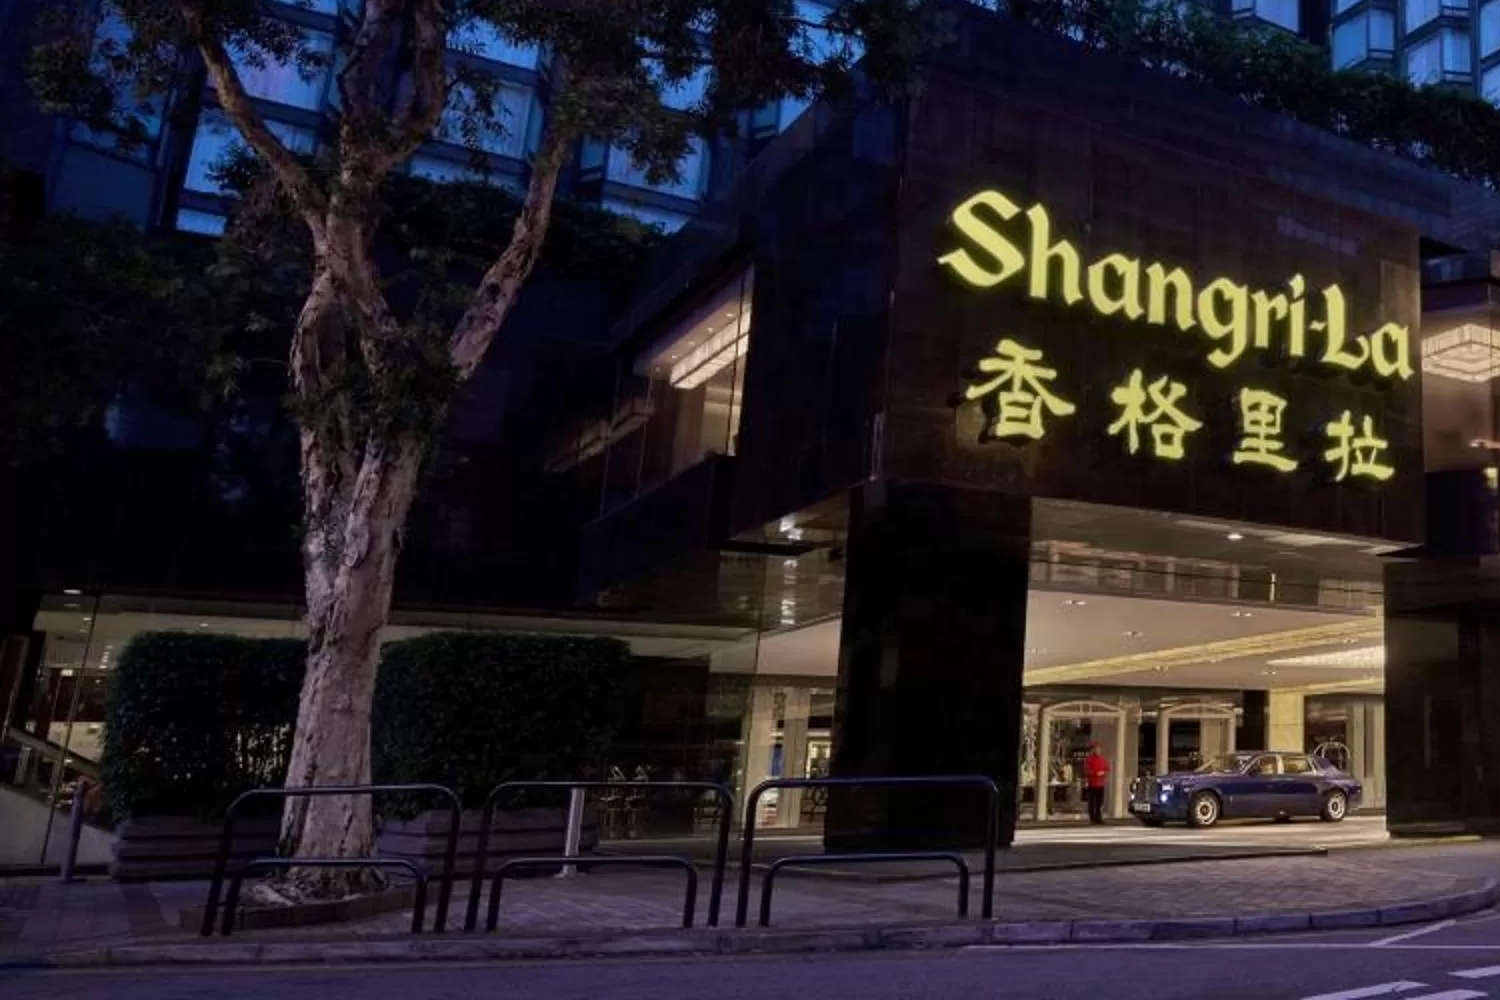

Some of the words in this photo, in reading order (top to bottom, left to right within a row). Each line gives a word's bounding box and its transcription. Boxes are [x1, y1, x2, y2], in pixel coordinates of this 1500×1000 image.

[938, 190, 1415, 380] Shangri-La
[966, 339, 1395, 481] 香格里拉
